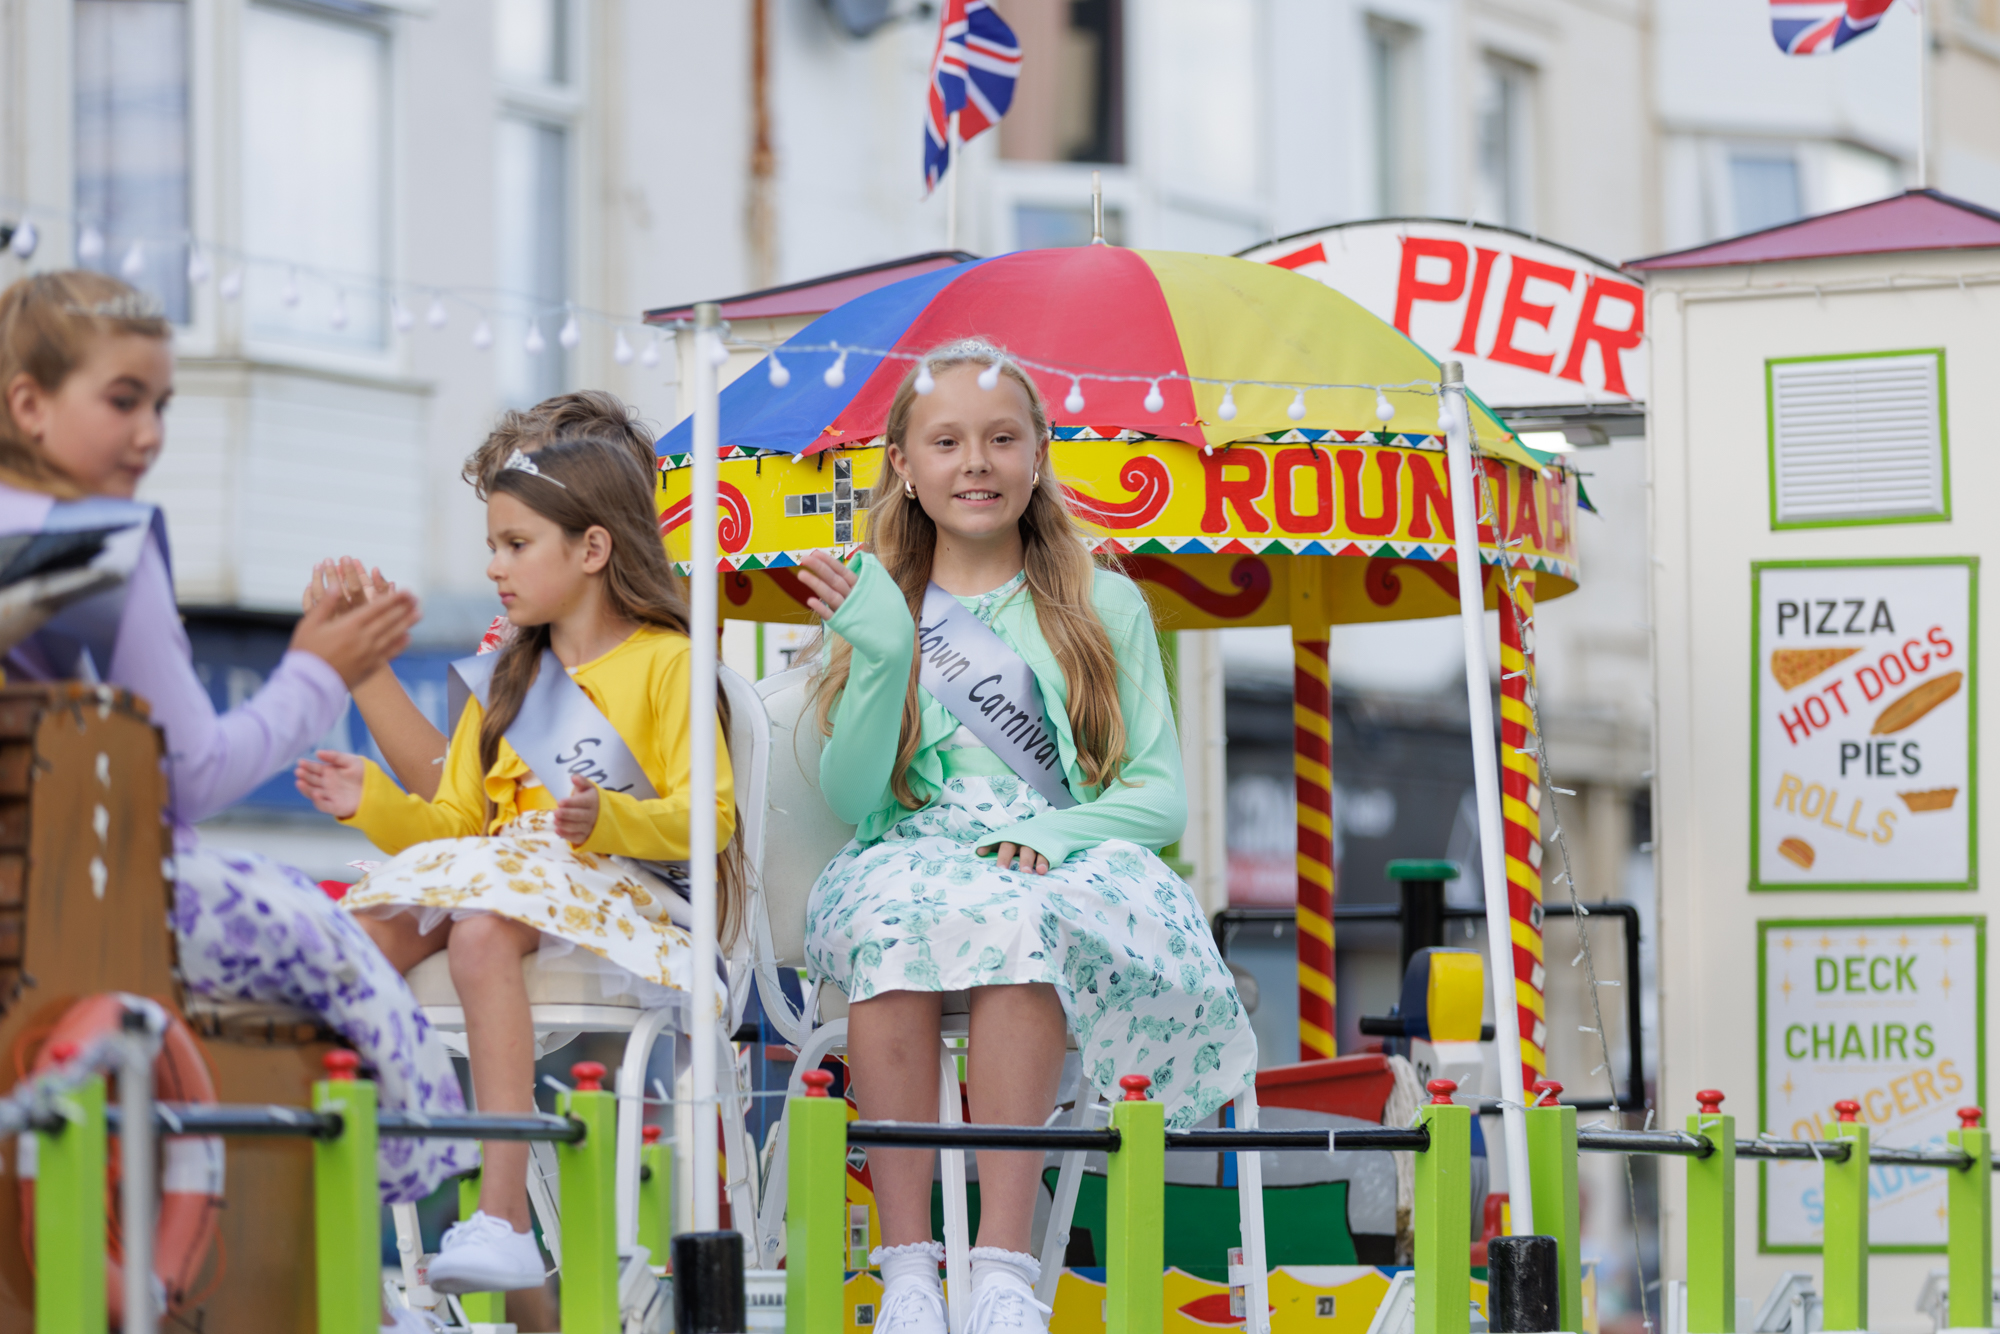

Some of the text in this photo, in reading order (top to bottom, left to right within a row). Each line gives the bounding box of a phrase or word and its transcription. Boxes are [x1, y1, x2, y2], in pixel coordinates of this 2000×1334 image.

[1394, 235, 1645, 400] PIER
[1201, 447, 1578, 558] ROUNDAB
[918, 616, 970, 683] down
[1777, 599, 1895, 636] PIZZA
[1778, 626, 1954, 745] HOT DOGS
[1840, 741, 1922, 777] PIES
[1774, 772, 1898, 845] ROLLS
[1815, 955, 1918, 993] DECK
[1784, 1022, 1936, 1061] CHAIRS
